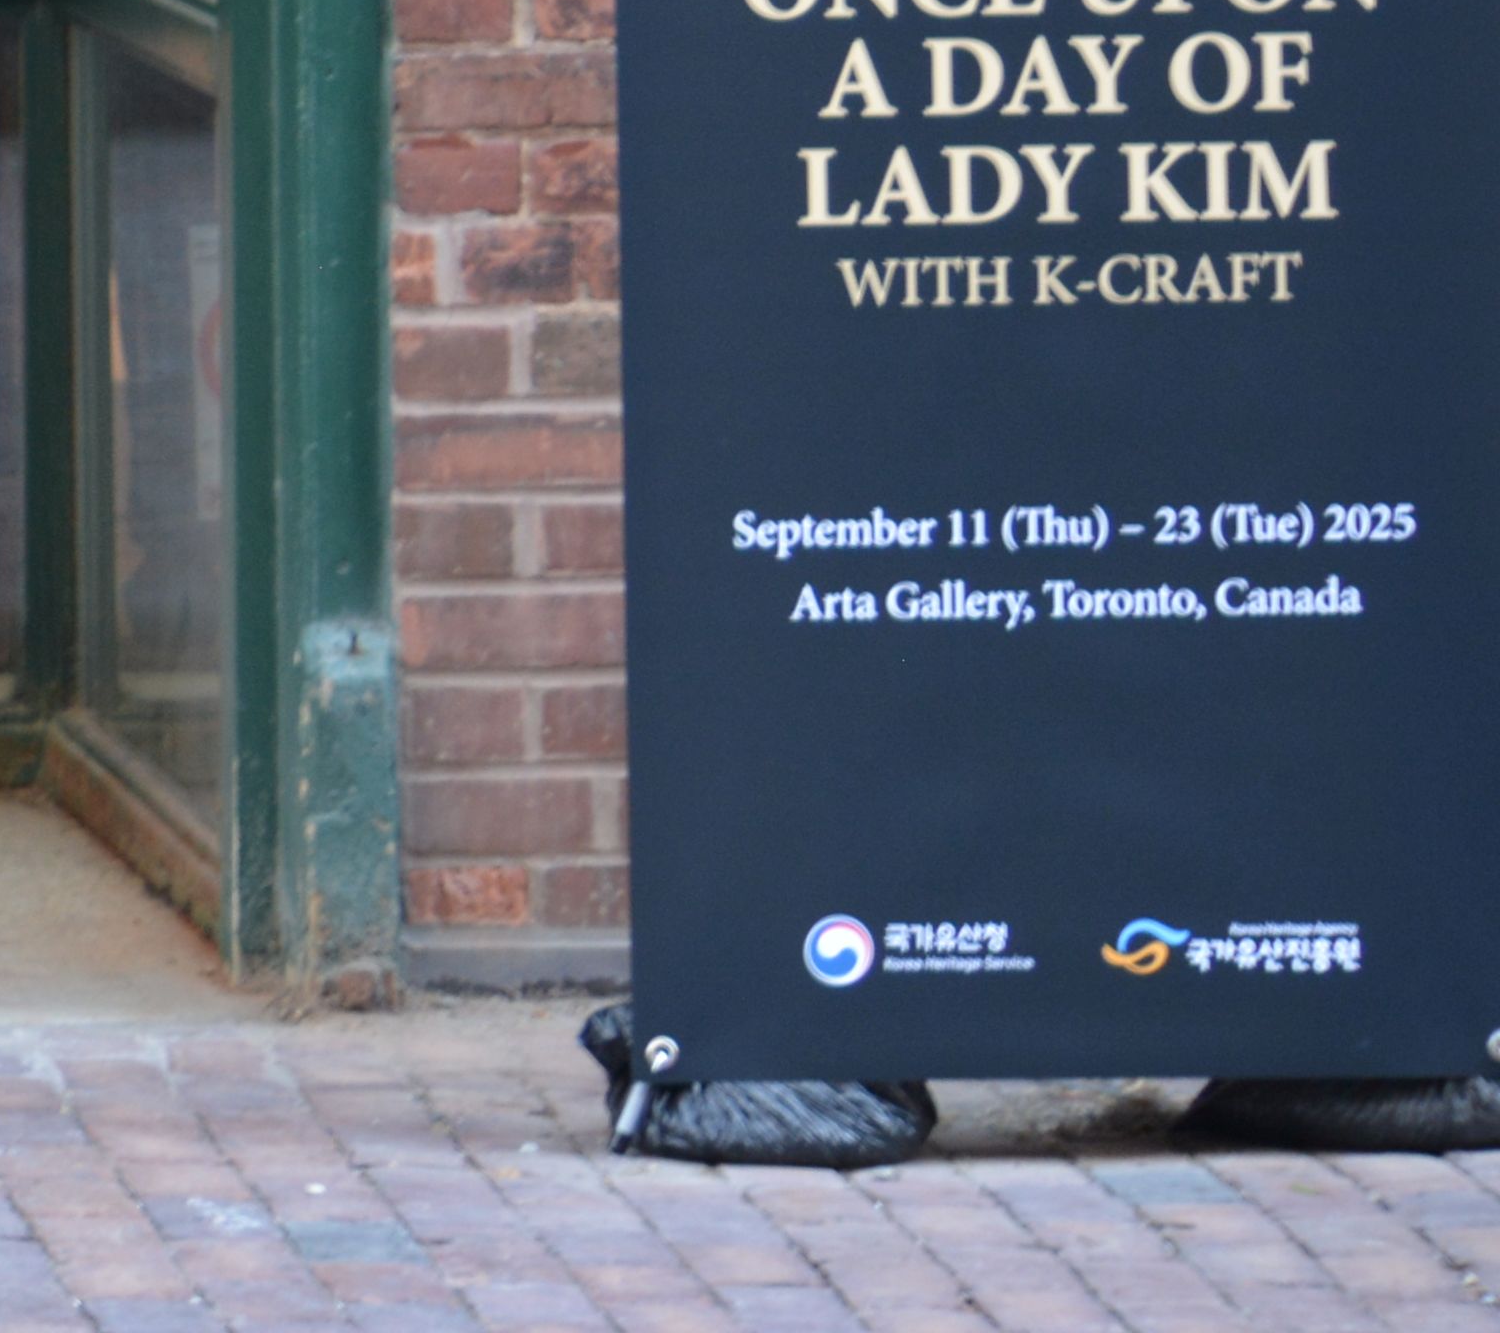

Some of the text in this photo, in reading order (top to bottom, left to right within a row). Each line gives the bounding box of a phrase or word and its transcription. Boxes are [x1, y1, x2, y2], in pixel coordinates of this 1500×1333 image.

[817, 30, 1314, 119] A DAY OF
[796, 139, 1340, 229] LADY KIM
[835, 252, 1304, 308] WITH K-CRAFT
[731, 506, 937, 561] September
[947, 508, 990, 548] 11
[1001, 503, 1109, 553] (Thu)
[1154, 506, 1202, 545] 23
[1210, 502, 1315, 551] (Tue)
[1323, 502, 1418, 544] 2025
[788, 574, 1363, 632] Arta Gallery, Toronto, Canada
[884, 921, 1009, 954] 국가유산청
[925, 955, 983, 974] Heritage
[1185, 937, 1362, 974] 국가유산진흥원
